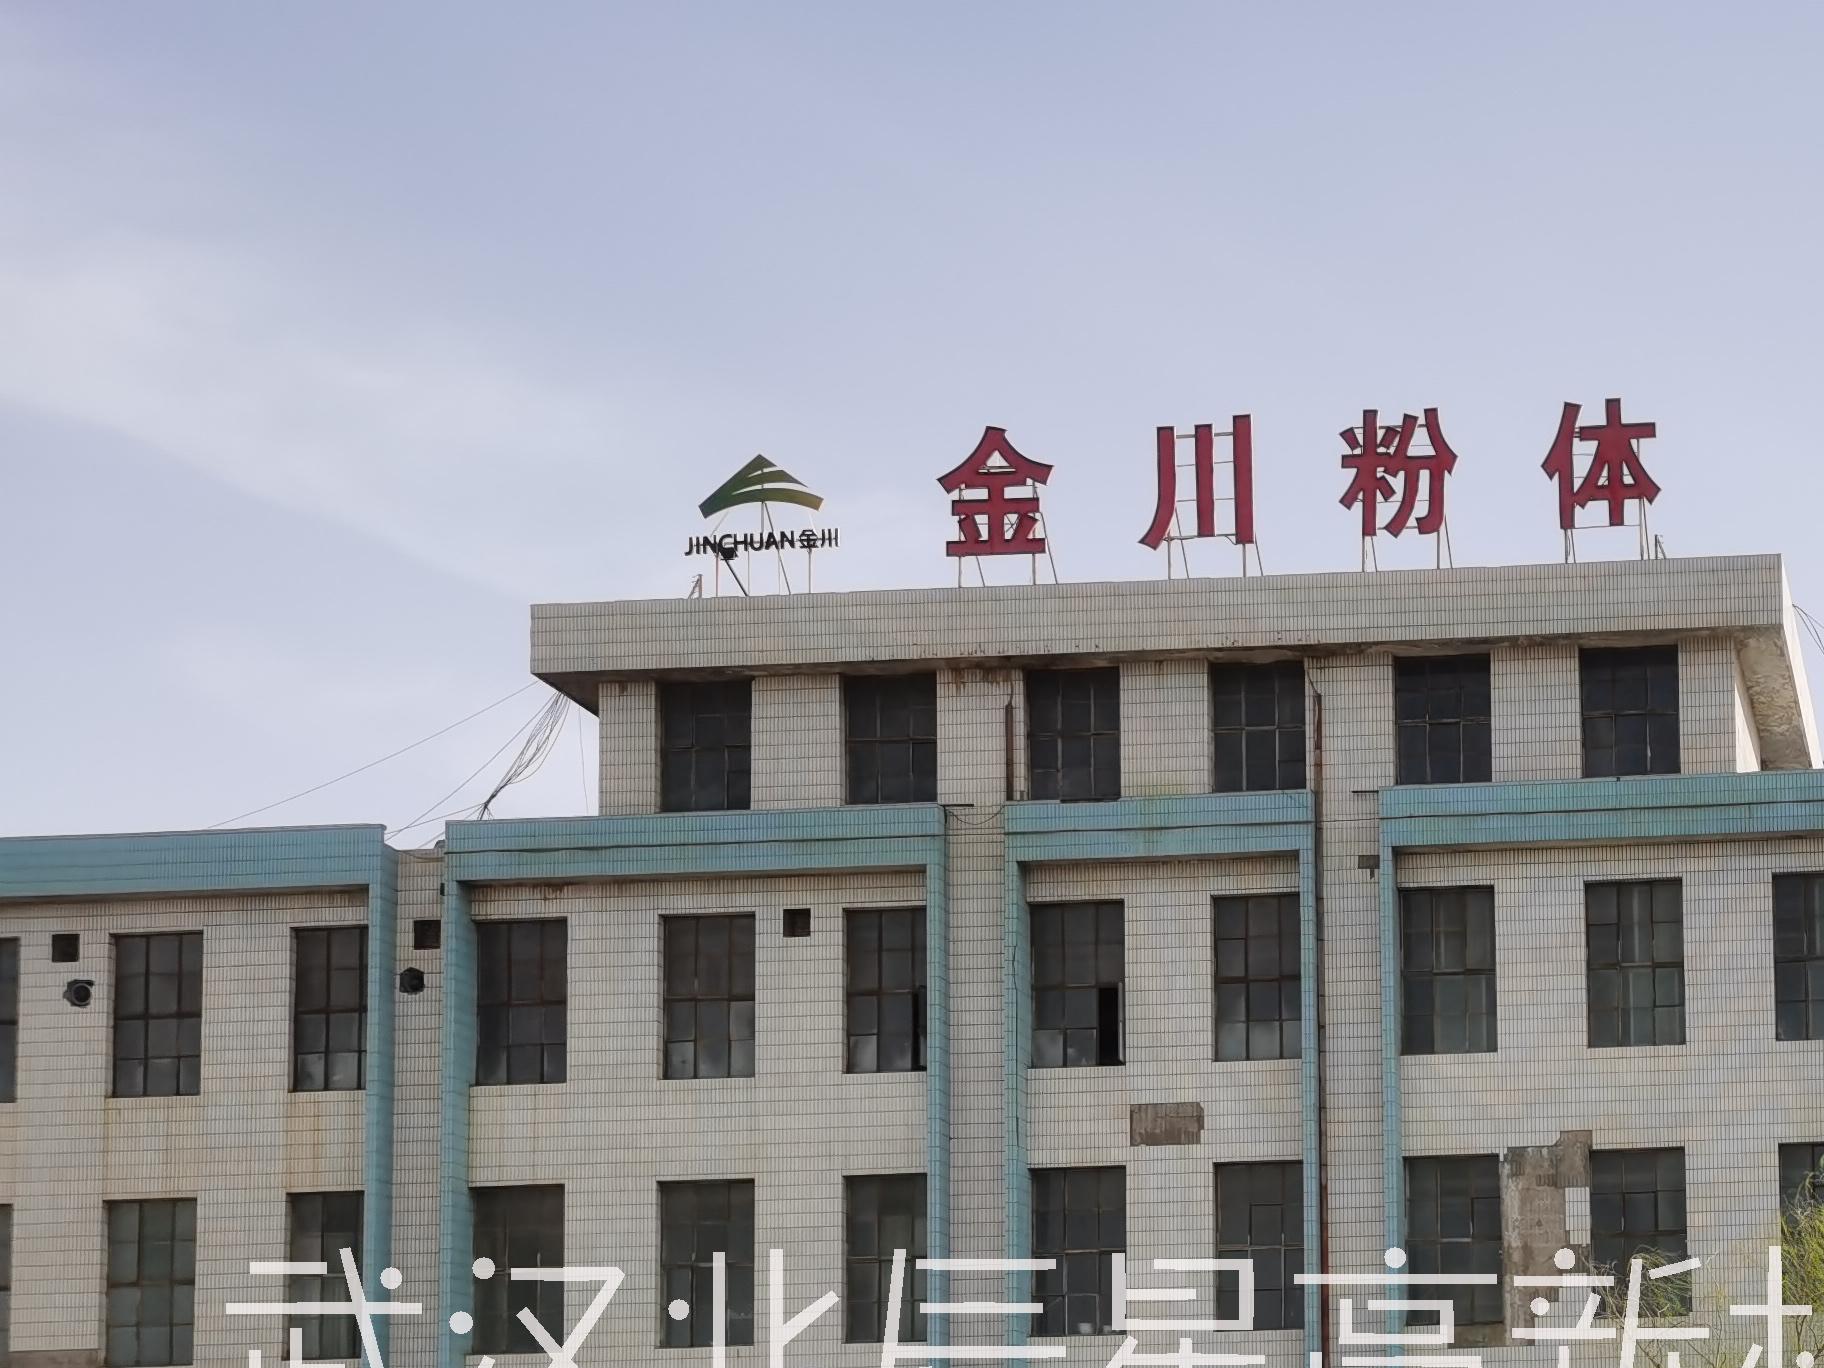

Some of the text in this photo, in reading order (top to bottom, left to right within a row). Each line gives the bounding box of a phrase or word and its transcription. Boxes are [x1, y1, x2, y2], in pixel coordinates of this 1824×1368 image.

[936, 398, 1661, 558] 金川粉体
[684, 528, 839, 557] JINCHUAN 金川
